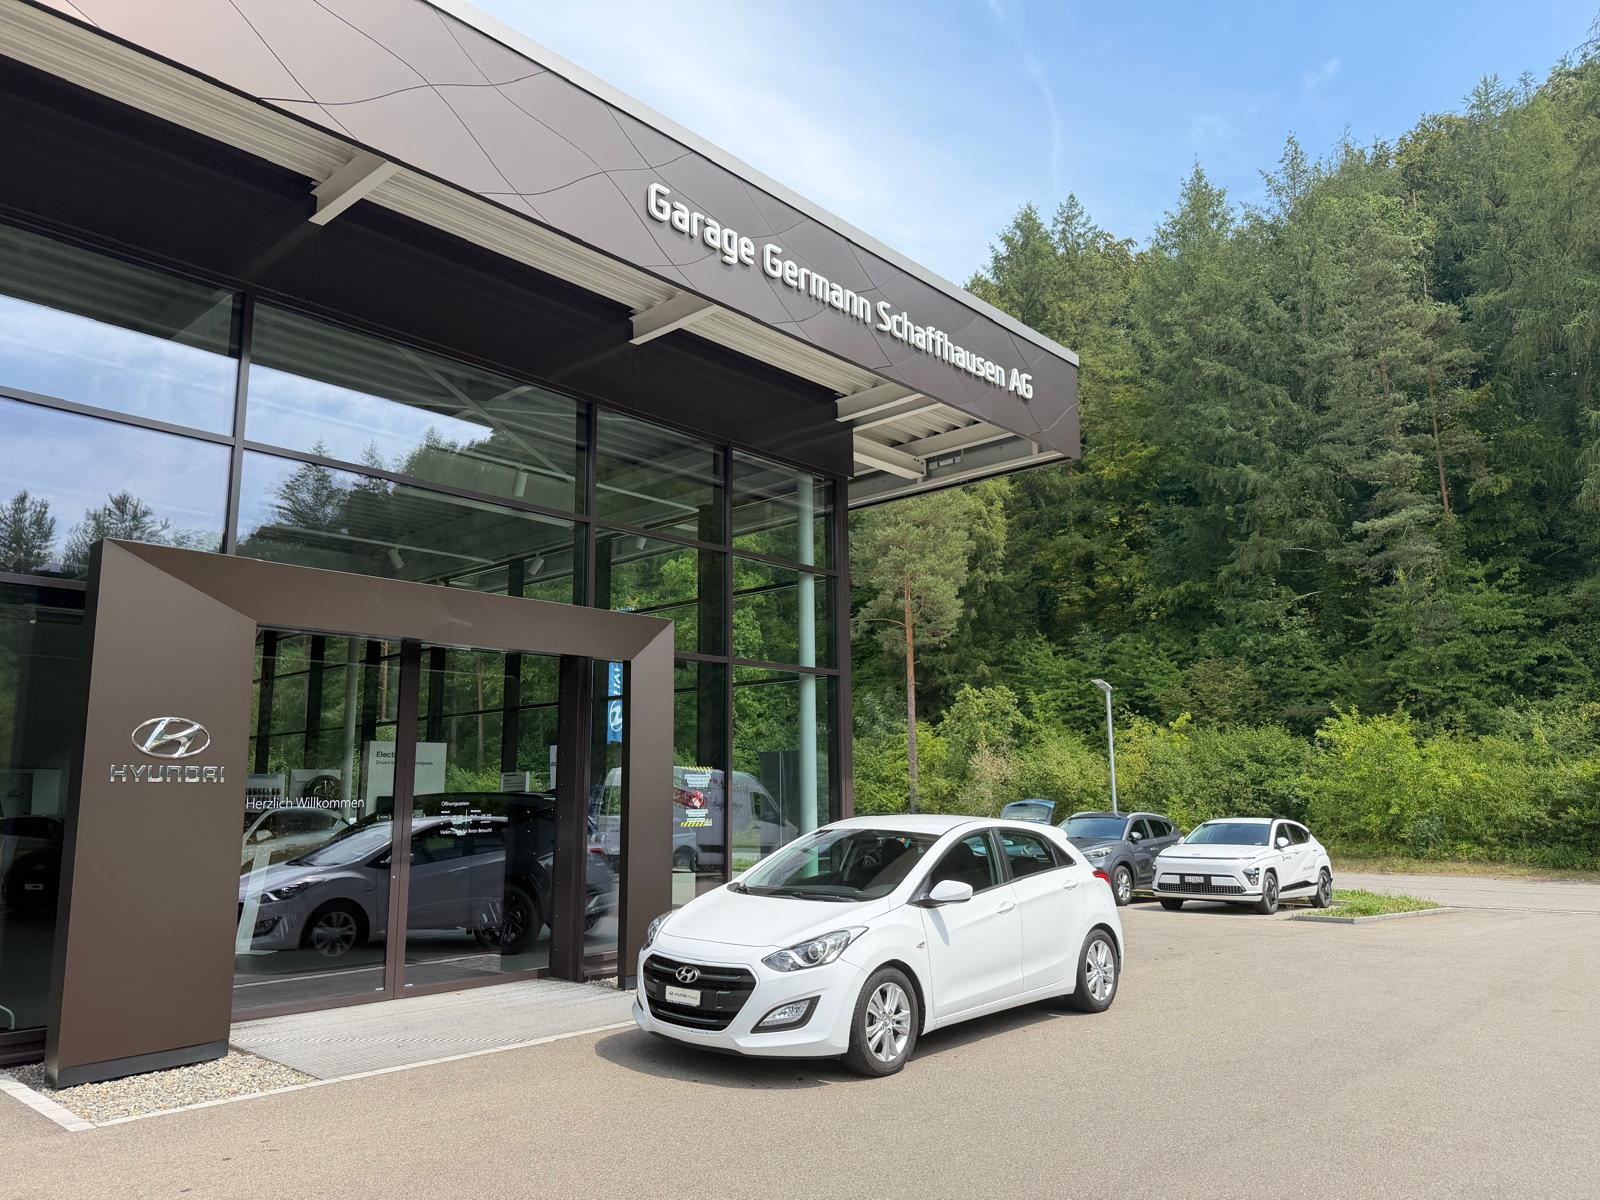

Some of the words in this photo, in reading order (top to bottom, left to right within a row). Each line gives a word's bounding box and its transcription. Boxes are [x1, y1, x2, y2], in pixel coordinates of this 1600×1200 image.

[647, 182, 755, 265] Garage
[763, 242, 871, 324] Germann
[876, 300, 1006, 388] Schaffhausen
[1008, 367, 1034, 400] AG
[376, 751, 396, 759] Elect
[109, 764, 225, 783] HYUNDAI
[246, 796, 293, 810] Herzlich
[295, 797, 365, 810] Willkommen
